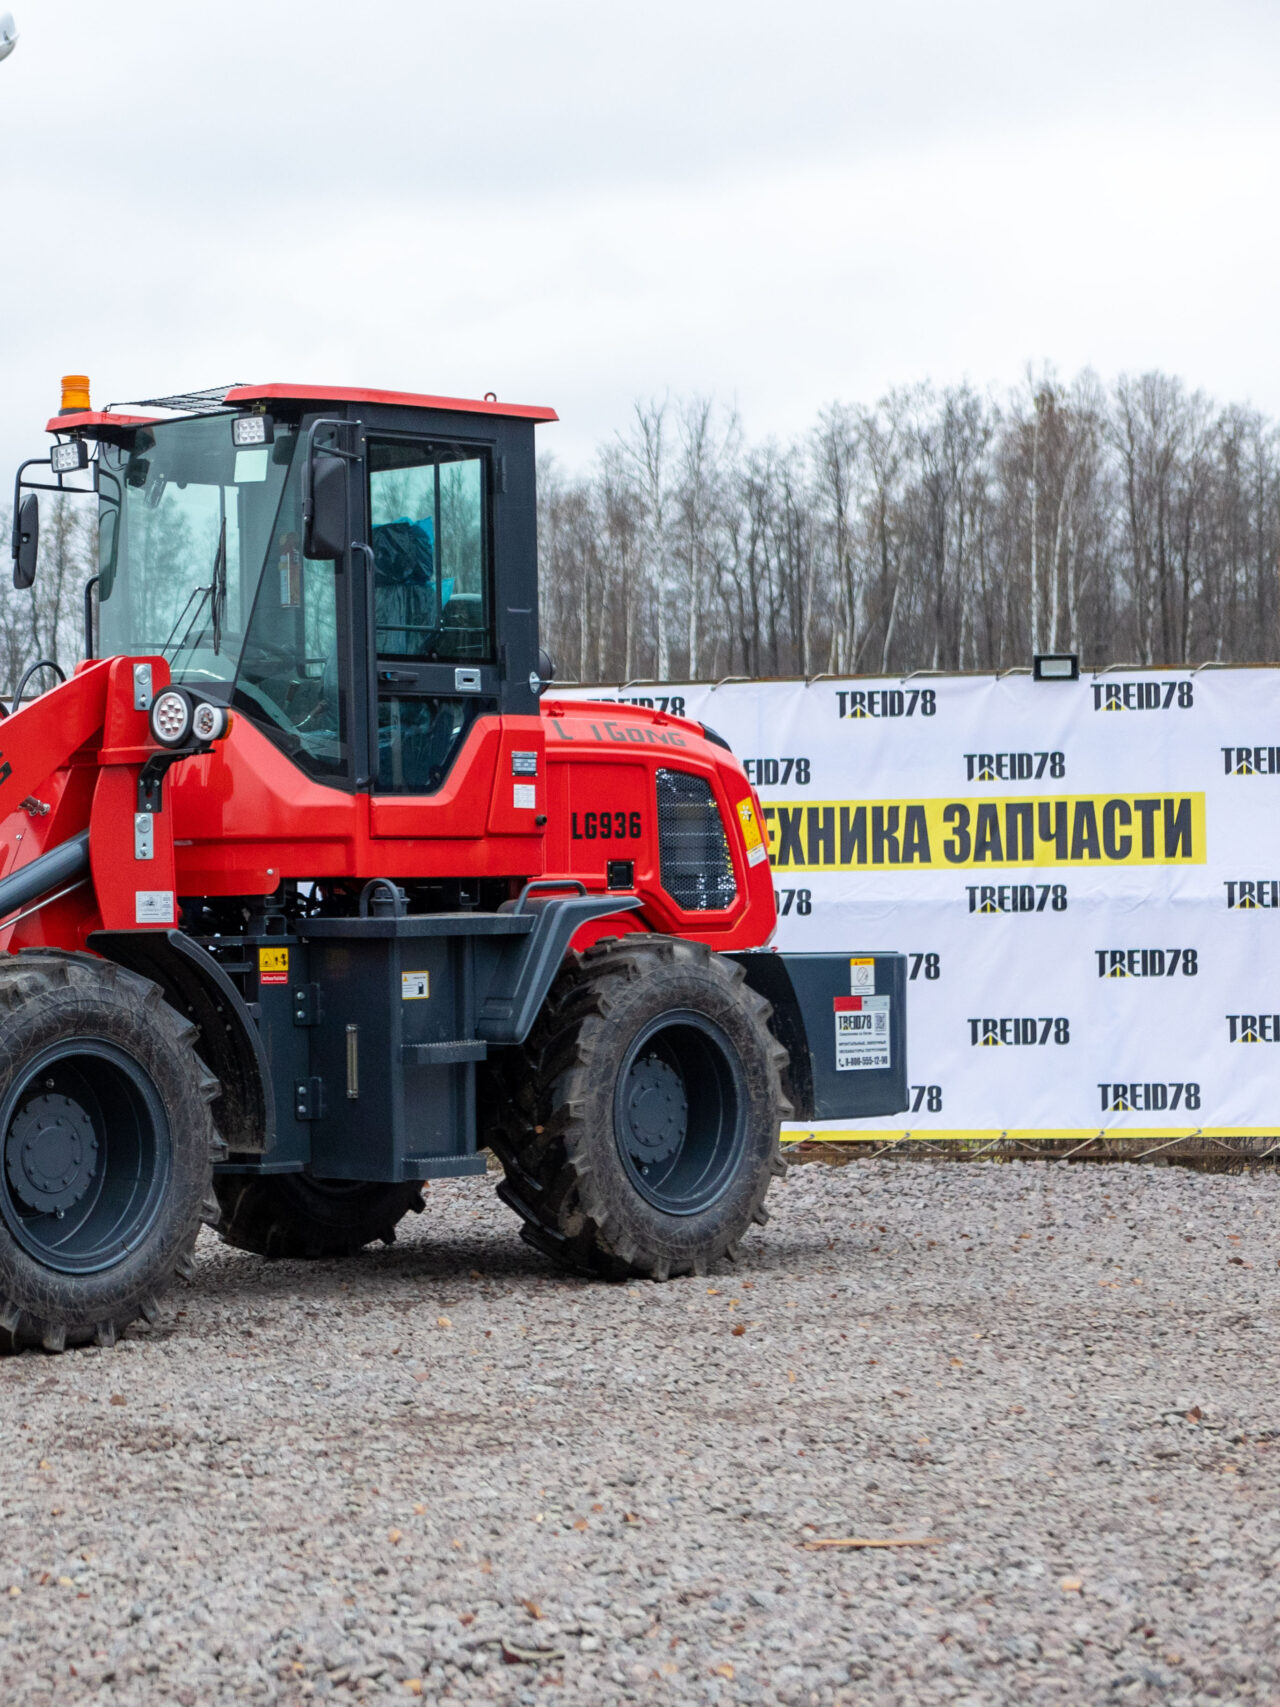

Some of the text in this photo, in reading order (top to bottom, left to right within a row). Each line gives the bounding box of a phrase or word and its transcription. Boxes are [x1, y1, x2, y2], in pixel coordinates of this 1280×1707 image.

[835, 690, 936, 718] TREID78
[1090, 682, 1193, 711] TREID78
[743, 758, 811, 785] EID78
[963, 751, 1065, 780] TREID78
[572, 812, 641, 839] LG936
[943, 798, 1192, 863] ЗАПЧАСТИ
[965, 885, 1068, 913] TREID78
[1223, 881, 1280, 909] TREI
[1095, 949, 1198, 978] TREID78
[838, 1015, 872, 1030] TREID78
[967, 1018, 1070, 1046] TREID78
[1097, 1083, 1200, 1112] TREID78
